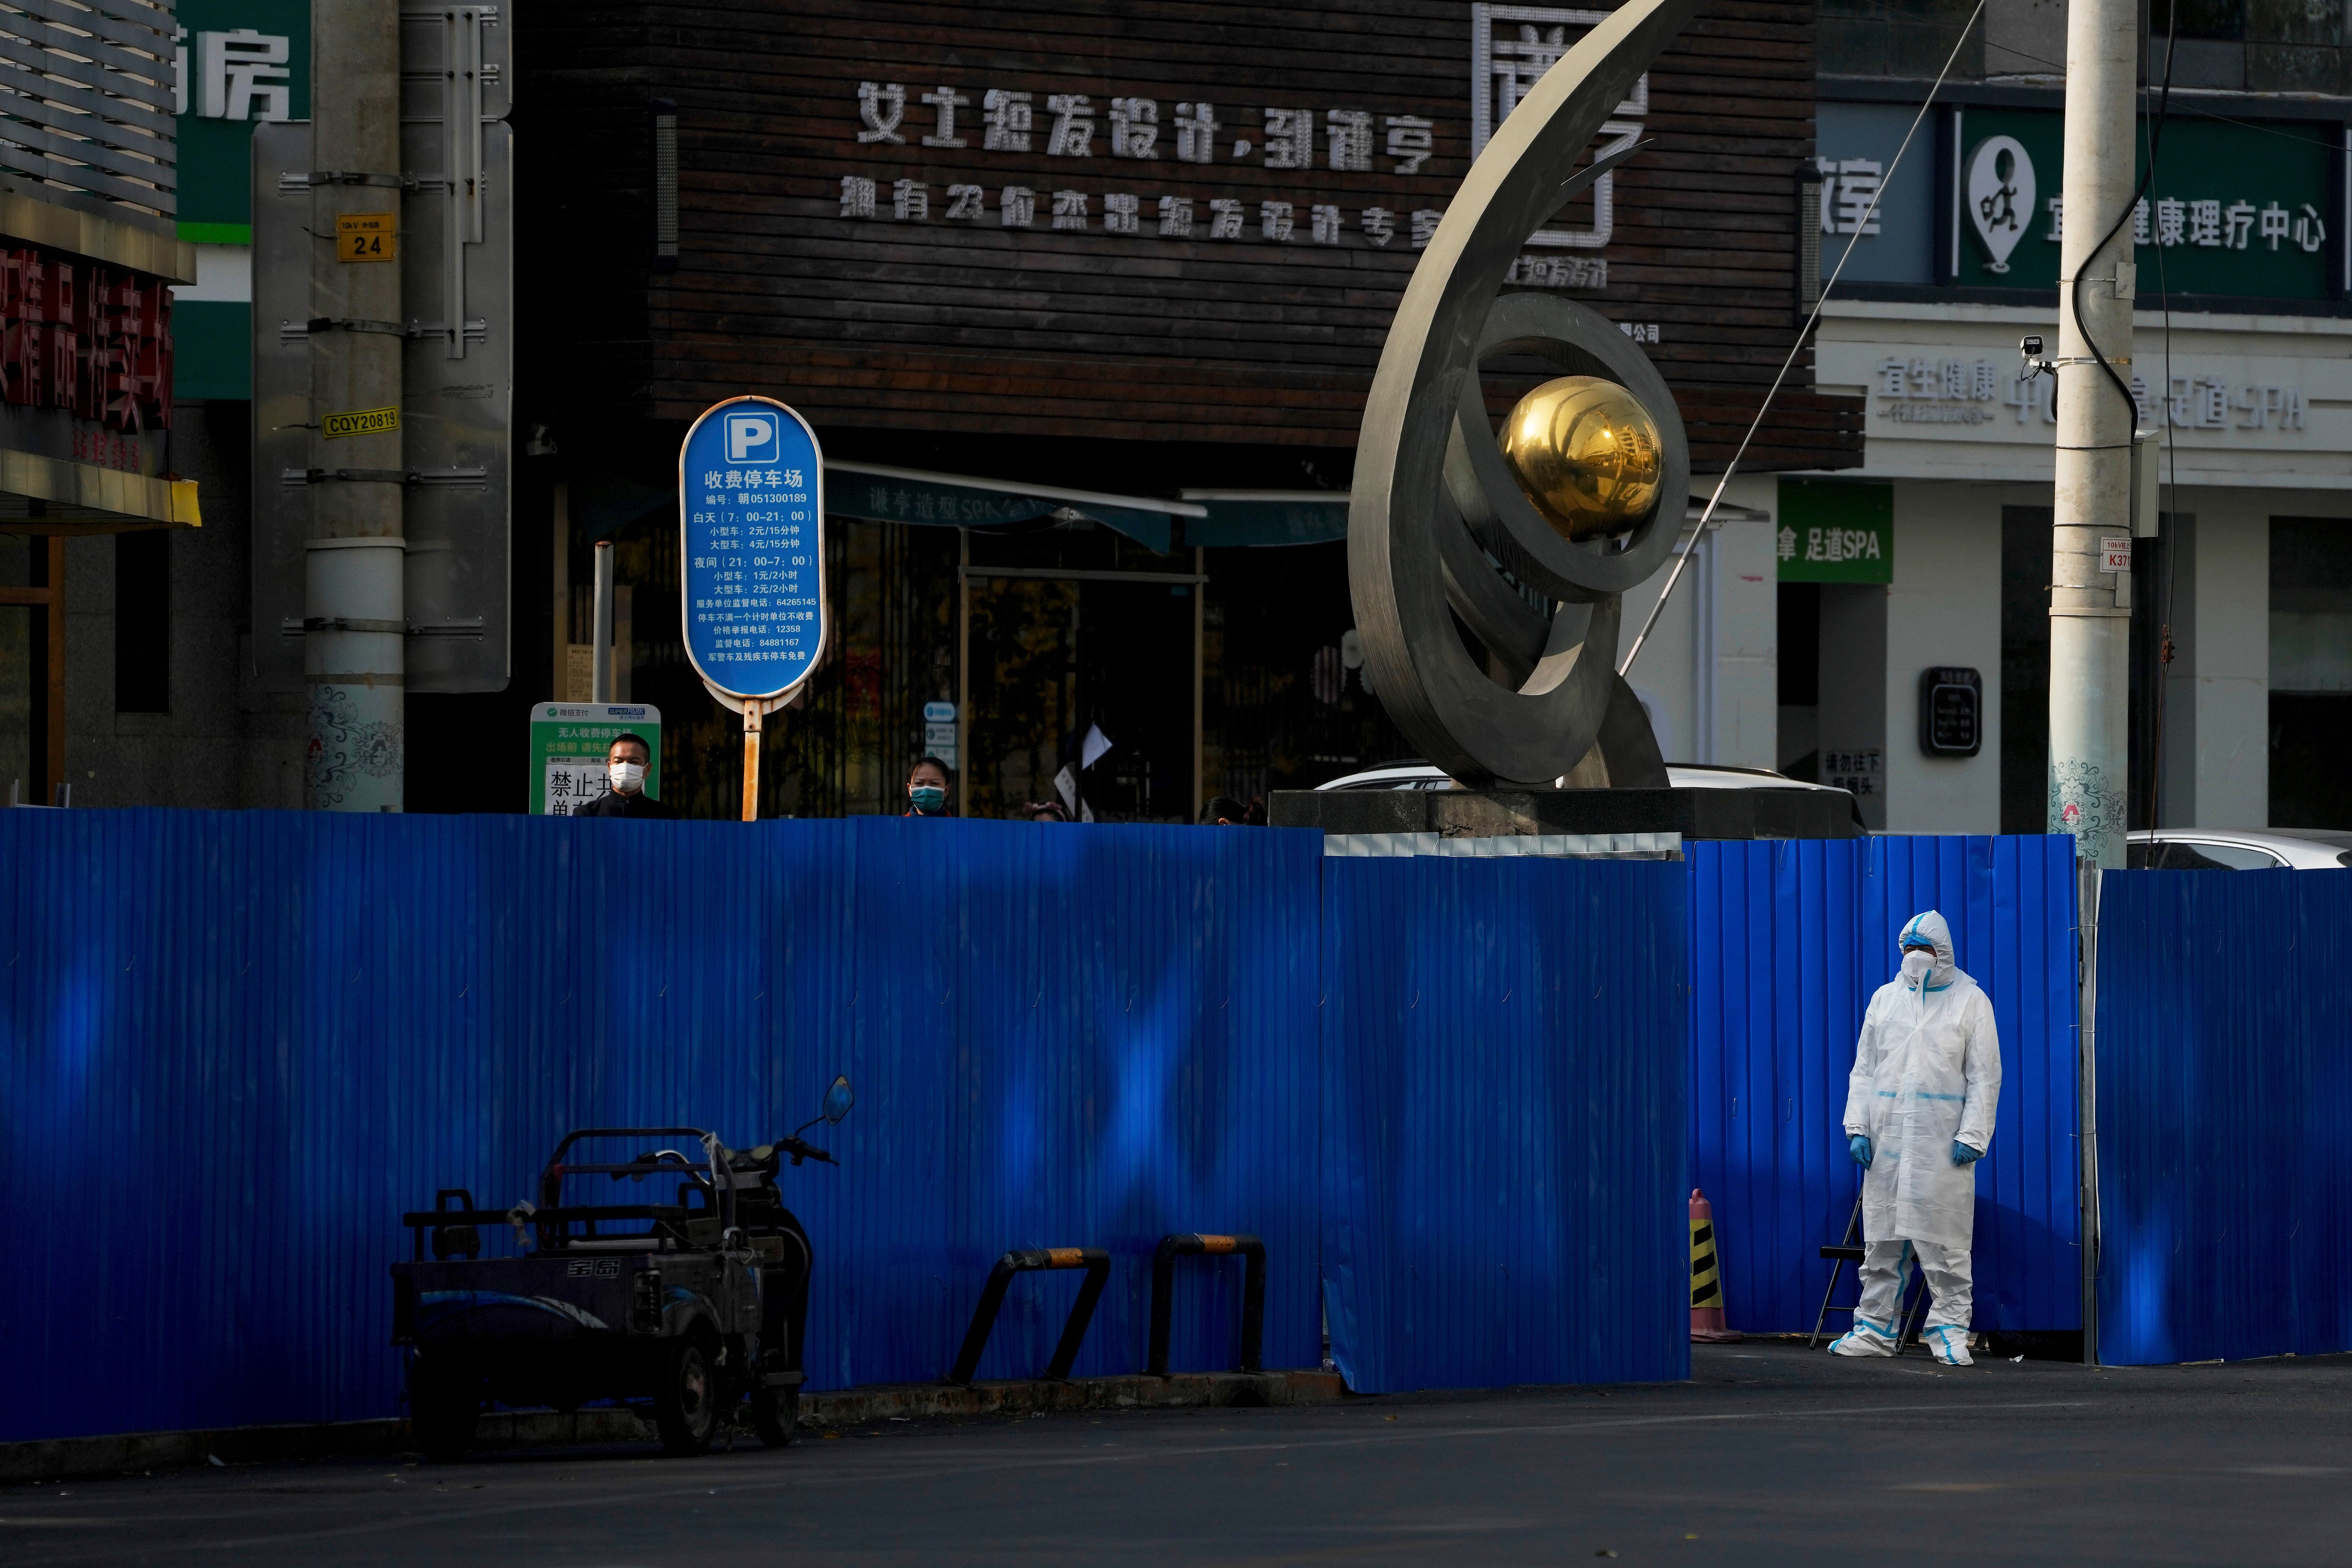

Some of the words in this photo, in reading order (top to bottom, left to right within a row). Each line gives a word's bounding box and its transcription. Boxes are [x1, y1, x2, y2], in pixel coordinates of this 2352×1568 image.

[175, 23, 289, 120] 房
[354, 236, 381, 254] 24
[0, 248, 175, 436] 精品特卖场
[330, 412, 394, 432] CQY20819
[731, 419, 772, 458] P
[704, 469, 803, 489] 收费停车场
[1805, 527, 1880, 561] 足道SPA
[698, 612, 813, 622] 停车不满一个计时单位不收费
[708, 651, 805, 662] 军警车及残疾车停车免费
[546, 742, 577, 752] 出场前
